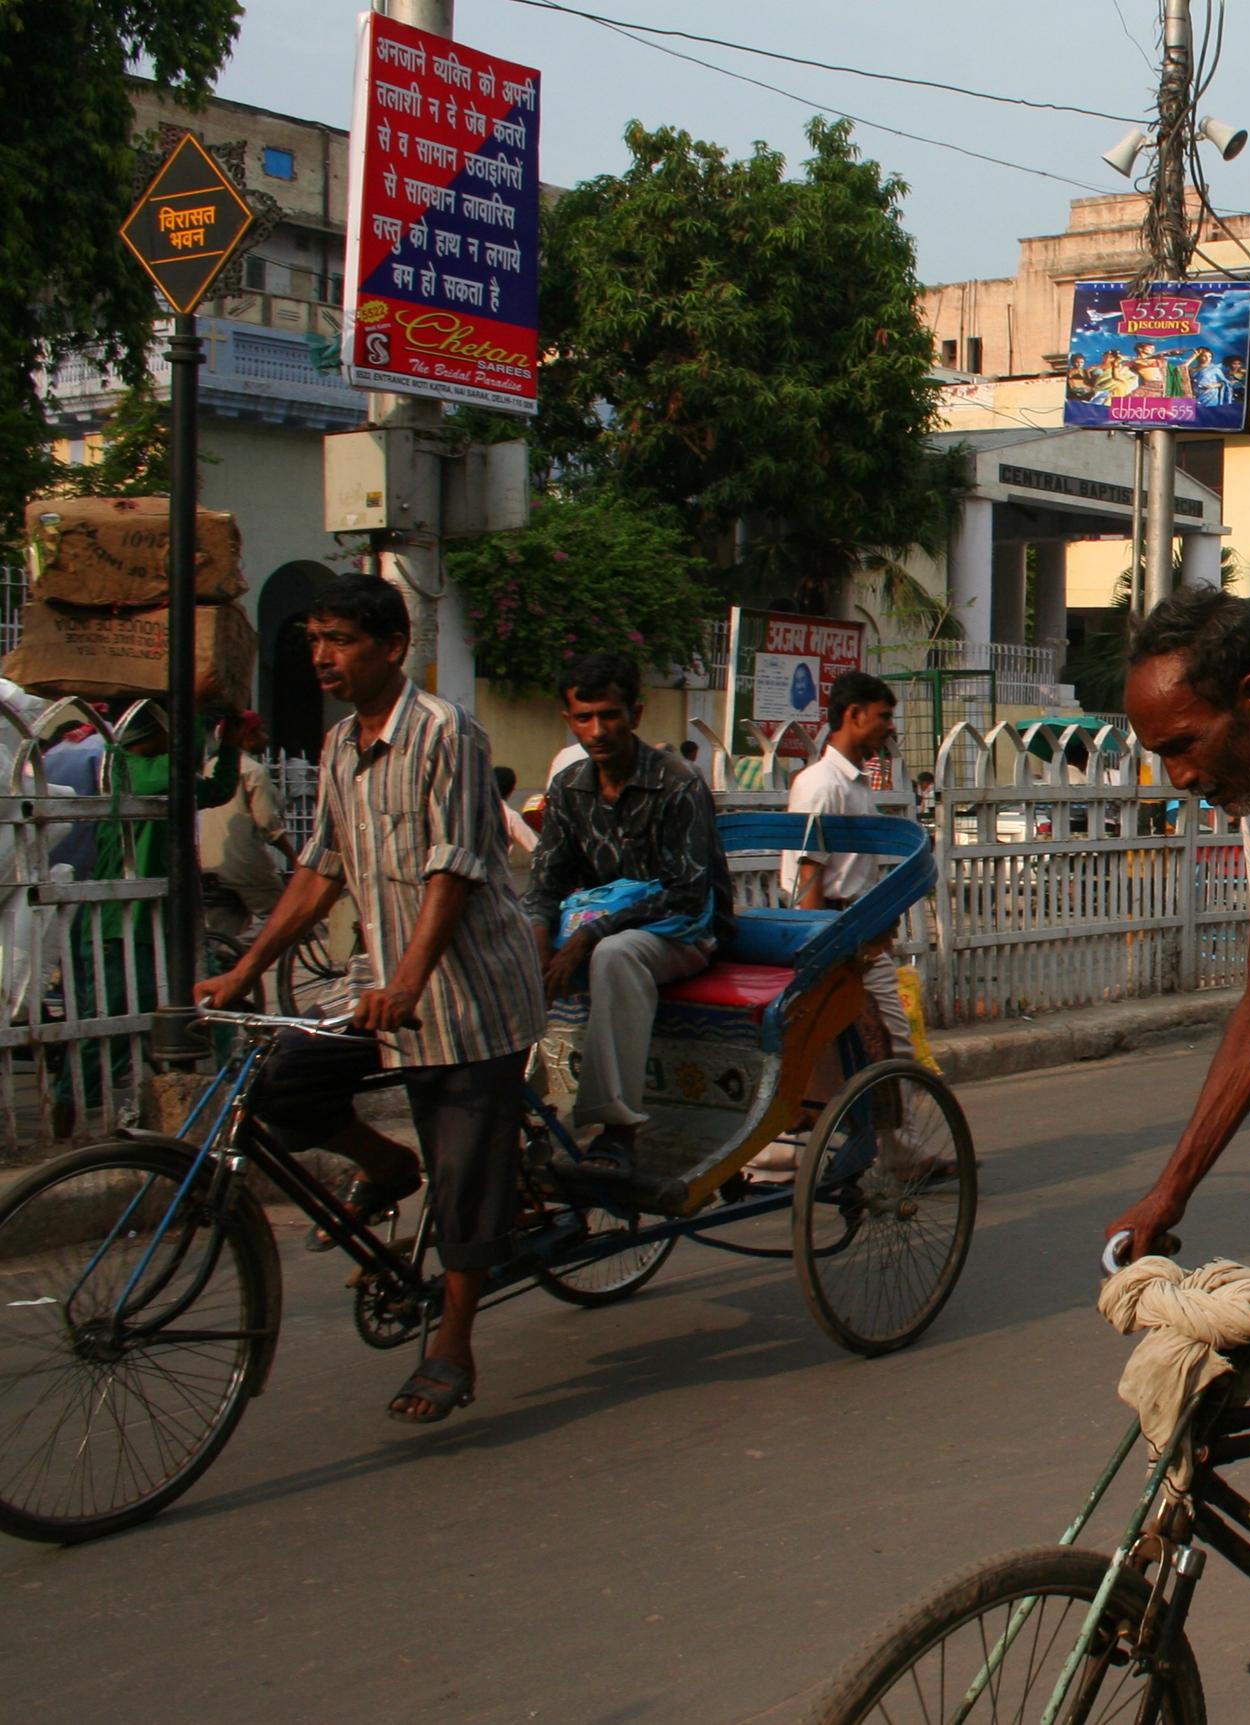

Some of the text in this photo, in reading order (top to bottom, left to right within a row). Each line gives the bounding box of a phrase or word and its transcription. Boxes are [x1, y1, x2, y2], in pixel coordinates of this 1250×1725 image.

[377, 37, 536, 111] अनजाने व्यक्ति को अपनी
[376, 80, 526, 149] तलाशी न दे जेब कतरो
[377, 117, 523, 190] से व सामान उठाइगिरों
[159, 206, 216, 232] विरासत
[383, 164, 515, 230] से सावधान लावारिस
[169, 228, 205, 249] भवन
[373, 214, 521, 273] वस्तु को हाथ न लगाये
[392, 261, 500, 312] बम हो सकता है
[362, 305, 385, 319] 5522
[396, 309, 531, 367] Chetan
[374, 372, 410, 386] ENTRANCE
[409, 358, 523, 391] The Bridal Paradise
[477, 361, 532, 379] SAREES
[1002, 466, 1074, 493] CENTRAL
[1080, 480, 1132, 503] BAPTIS
